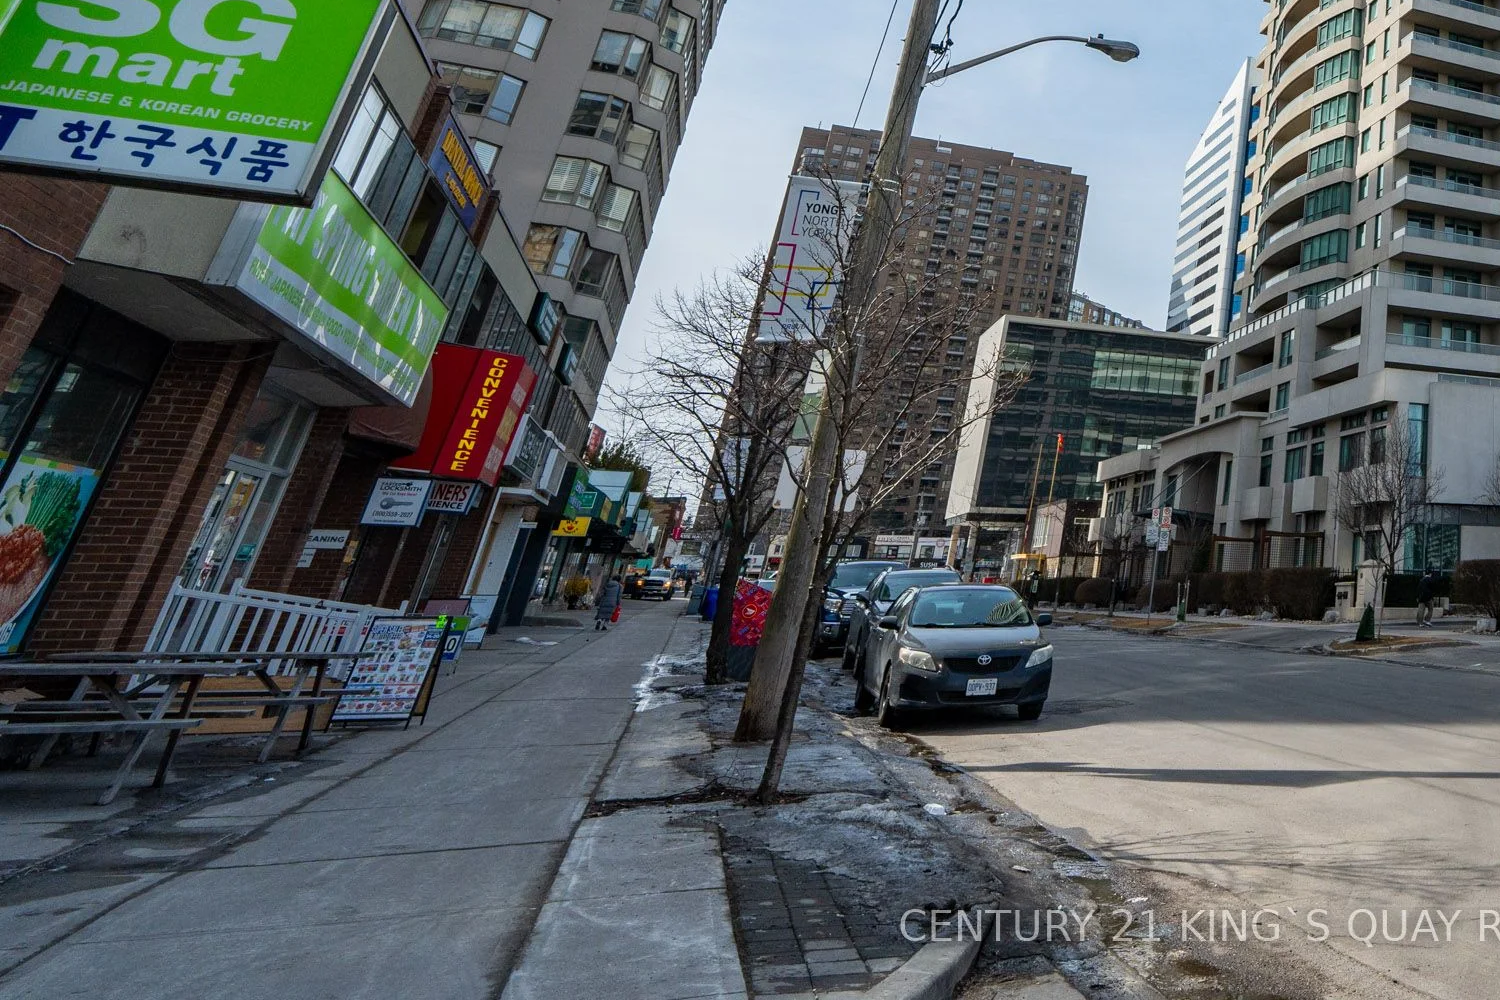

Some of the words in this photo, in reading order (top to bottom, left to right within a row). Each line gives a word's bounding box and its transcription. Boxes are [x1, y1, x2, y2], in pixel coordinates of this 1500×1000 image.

[32, 38, 245, 97] mart
[1, 80, 114, 104] JAPANESE
[118, 96, 133, 107] &
[139, 98, 221, 120] KOREAN
[225, 111, 313, 132] GROCERY
[58, 119, 289, 183] 한국식품
[450, 357, 508, 471] CONVENIENCE
[380, 485, 422, 493] LOCKSMITH
